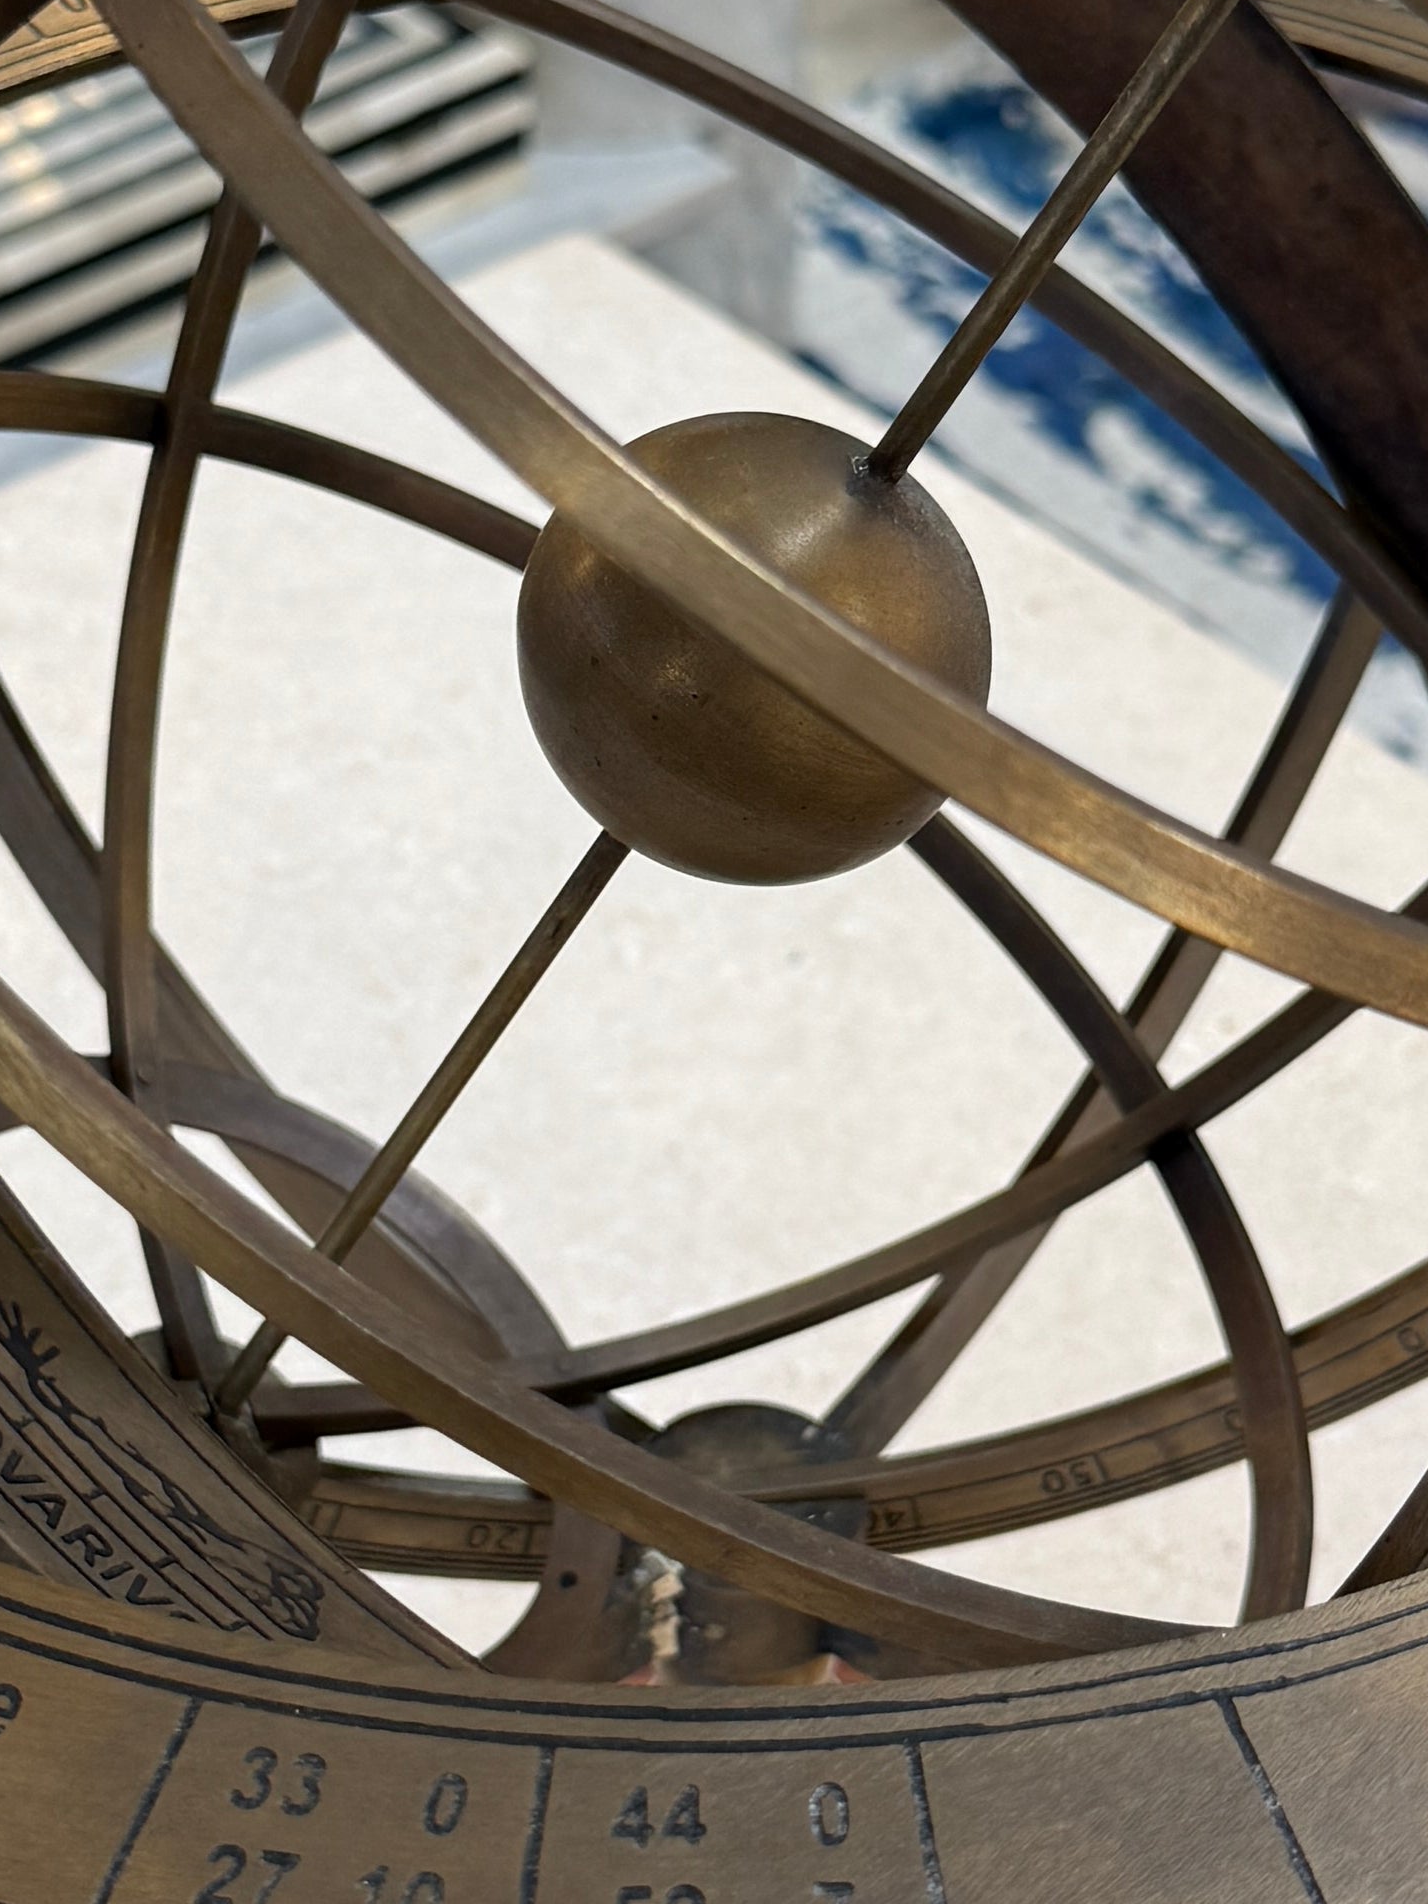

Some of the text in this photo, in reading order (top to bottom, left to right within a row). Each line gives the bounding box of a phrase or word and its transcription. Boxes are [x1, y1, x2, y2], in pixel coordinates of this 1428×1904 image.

[1040, 1455, 1097, 1496] 50
[229, 1745, 470, 1837] 33 0
[609, 1780, 851, 1849] 44 0
